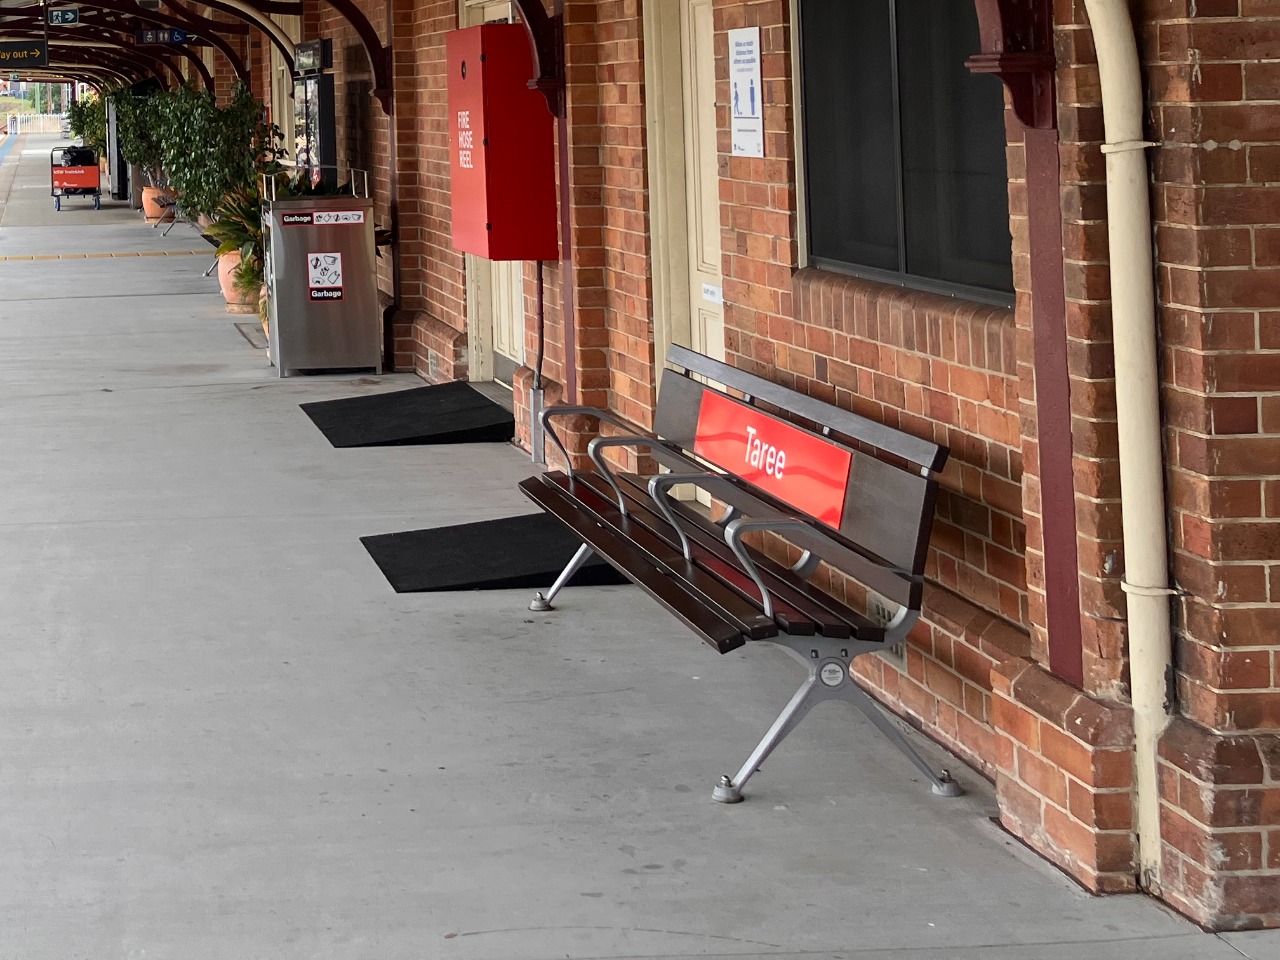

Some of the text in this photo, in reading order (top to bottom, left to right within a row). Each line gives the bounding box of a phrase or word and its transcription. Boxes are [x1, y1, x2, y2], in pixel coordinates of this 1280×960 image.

[12, 50, 28, 58] out
[457, 111, 470, 128] FIRE
[458, 130, 473, 148] HOSE
[459, 149, 473, 168] REEL
[311, 290, 342, 298] Garbage
[744, 425, 786, 480] Taree
